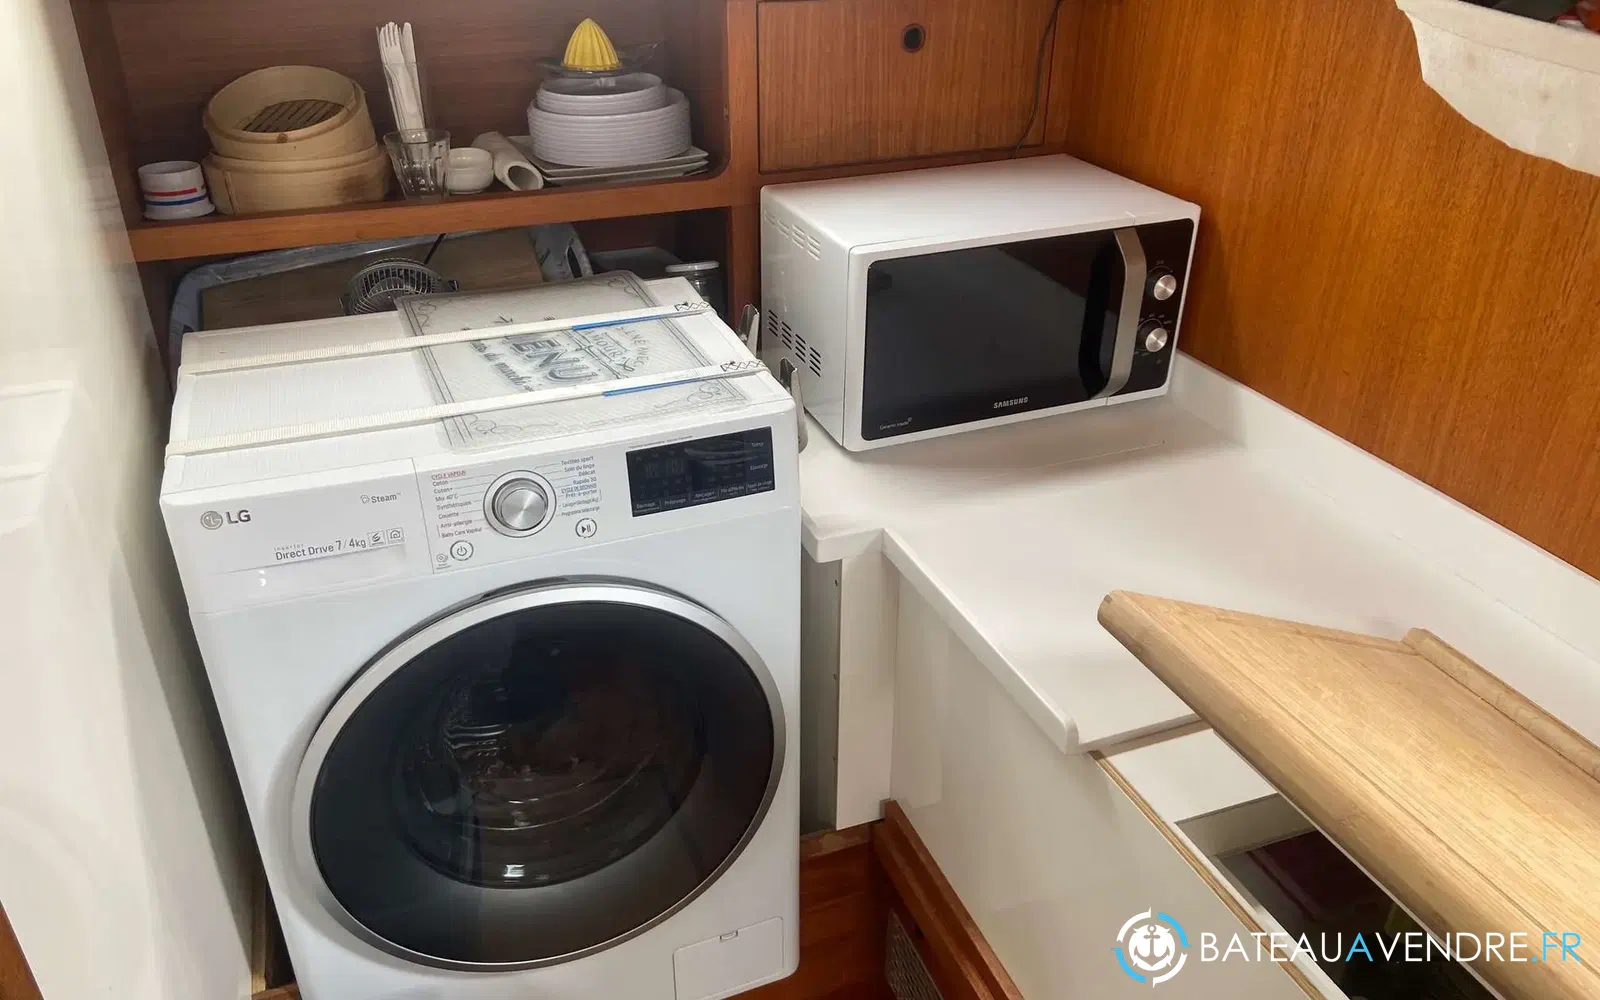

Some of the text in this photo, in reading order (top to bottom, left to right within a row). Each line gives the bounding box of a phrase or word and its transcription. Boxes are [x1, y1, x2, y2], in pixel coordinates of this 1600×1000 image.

[993, 396, 1029, 409] SAMSUNG
[226, 509, 251, 525] LG
[275, 548, 307, 561] Direct
[308, 544, 335, 556] Drive
